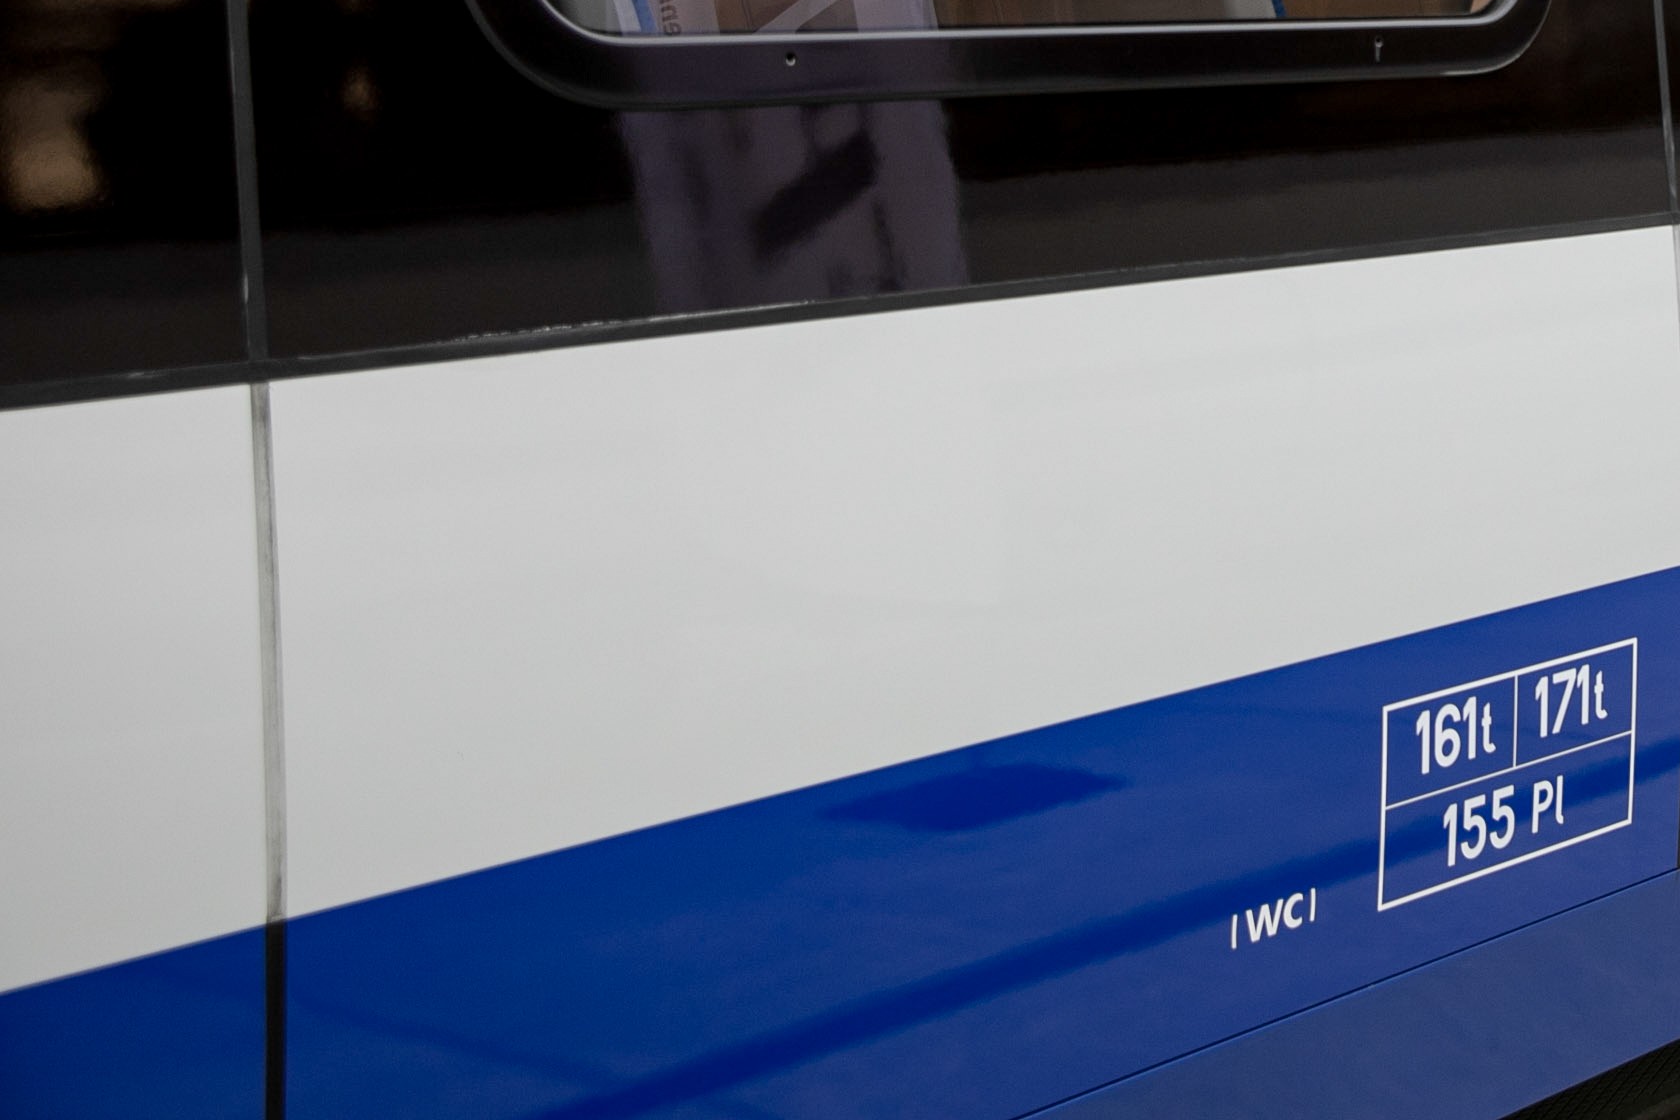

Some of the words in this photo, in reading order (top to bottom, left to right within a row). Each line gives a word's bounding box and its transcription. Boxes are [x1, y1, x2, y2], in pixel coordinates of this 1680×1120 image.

[1415, 695, 1497, 775] 161t
[1534, 663, 1609, 738] 171t
[1443, 784, 1516, 867] 155
